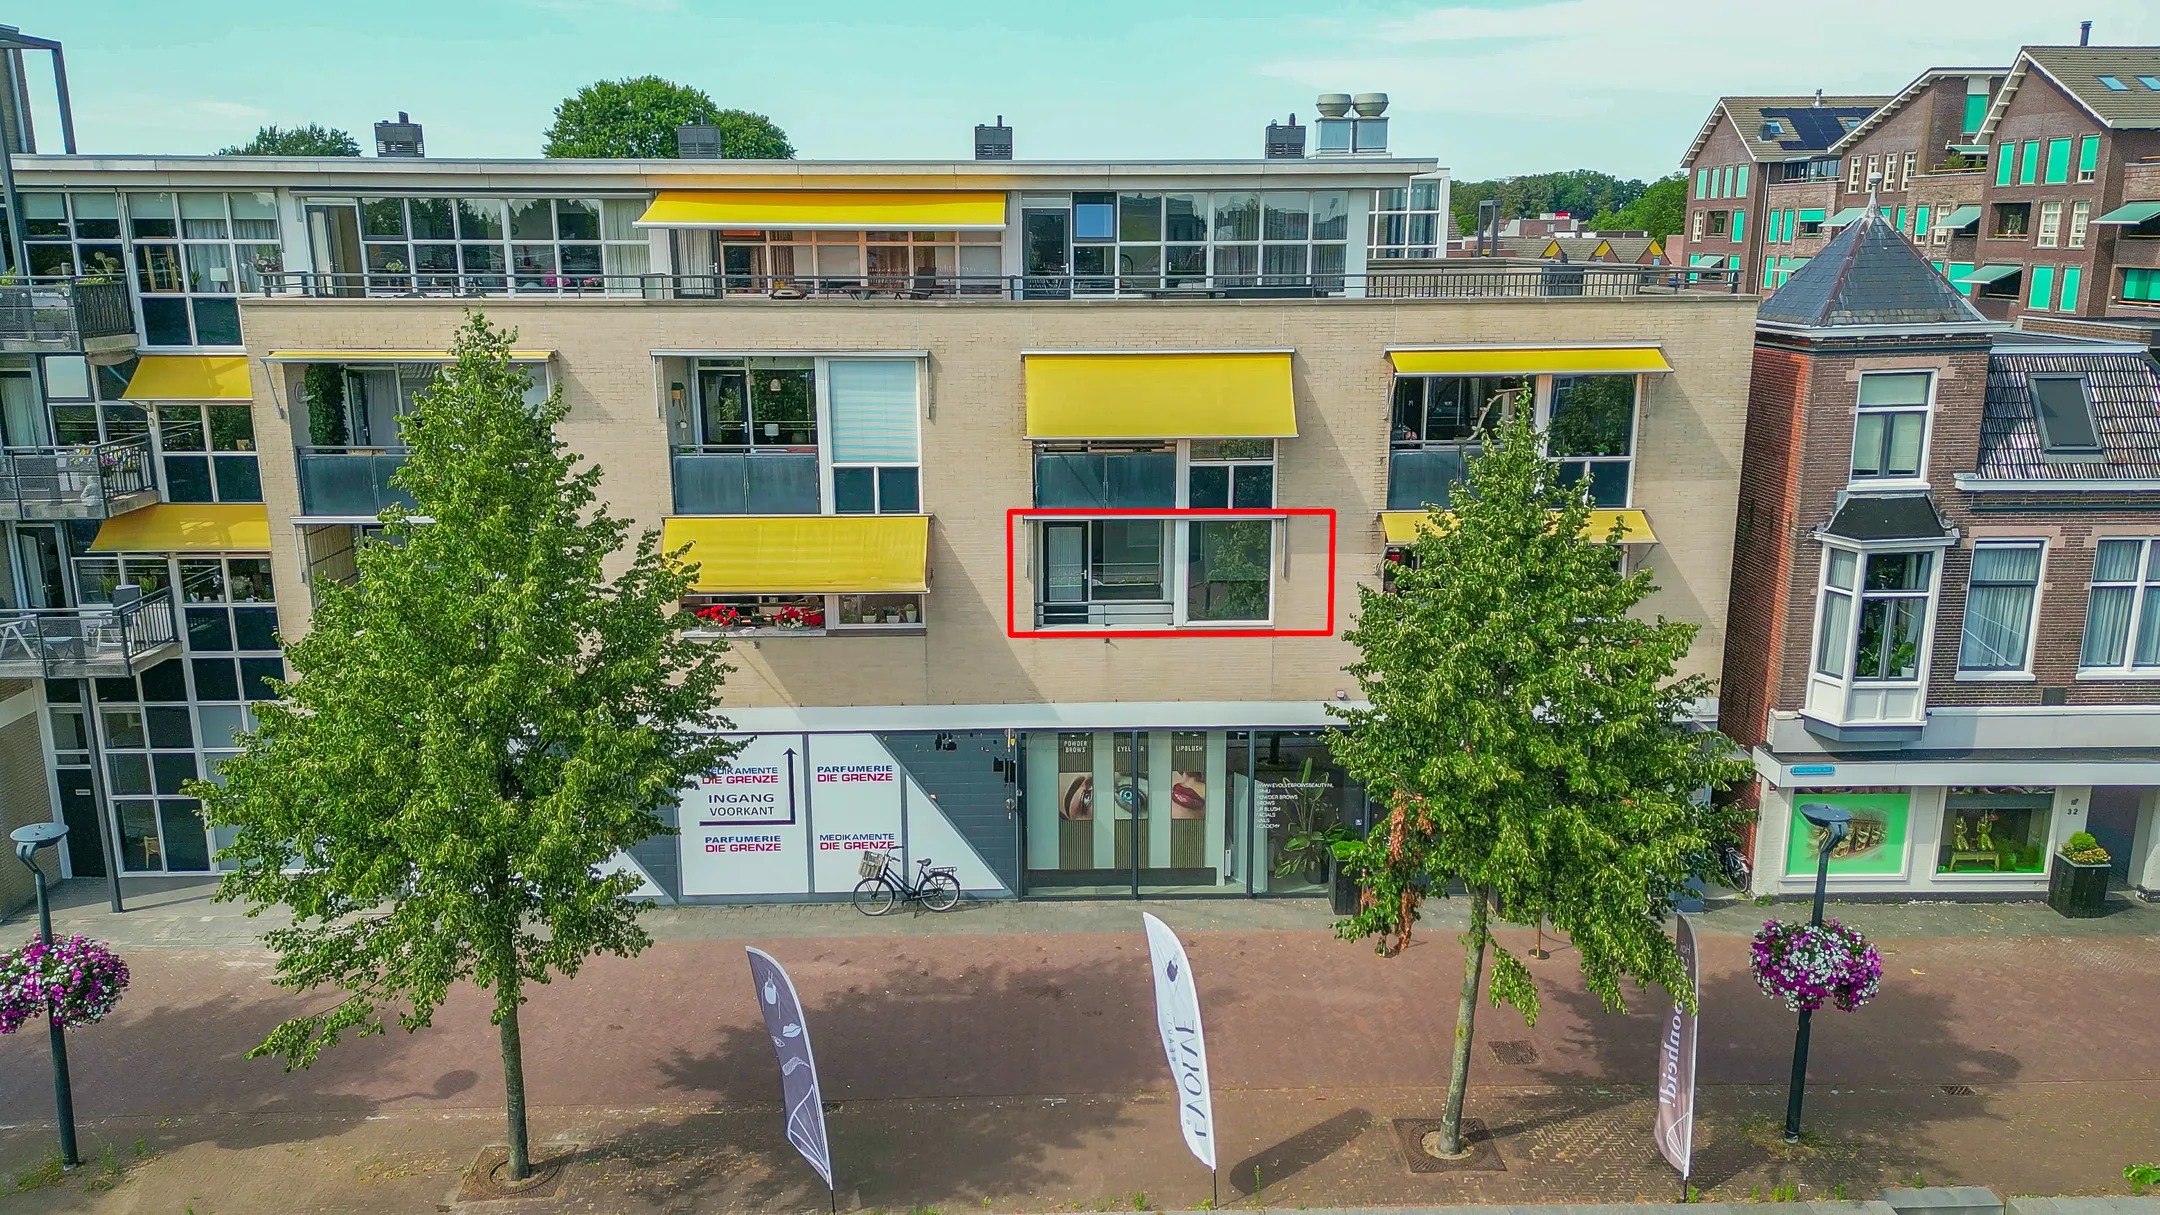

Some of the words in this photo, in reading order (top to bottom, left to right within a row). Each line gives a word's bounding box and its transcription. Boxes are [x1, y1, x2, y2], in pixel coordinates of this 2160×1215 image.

[703, 767, 779, 775] EDIKAMENTE
[817, 765, 893, 773] PARFUMERIE
[702, 775, 722, 784] DIE
[726, 775, 779, 784] GRENZE
[817, 774, 838, 782] DIE
[842, 773, 893, 782] GRENZE
[708, 794, 774, 804] INGANG
[709, 806, 774, 816] VOORKANT
[2067, 808, 2079, 816] 32
[705, 836, 781, 844] PARFUMERIE
[820, 833, 895, 841] MEDIKAMENTE
[705, 844, 726, 853] DIE
[729, 843, 781, 852] GRENZE
[820, 842, 840, 850] DIE
[844, 841, 895, 849] GRENZE
